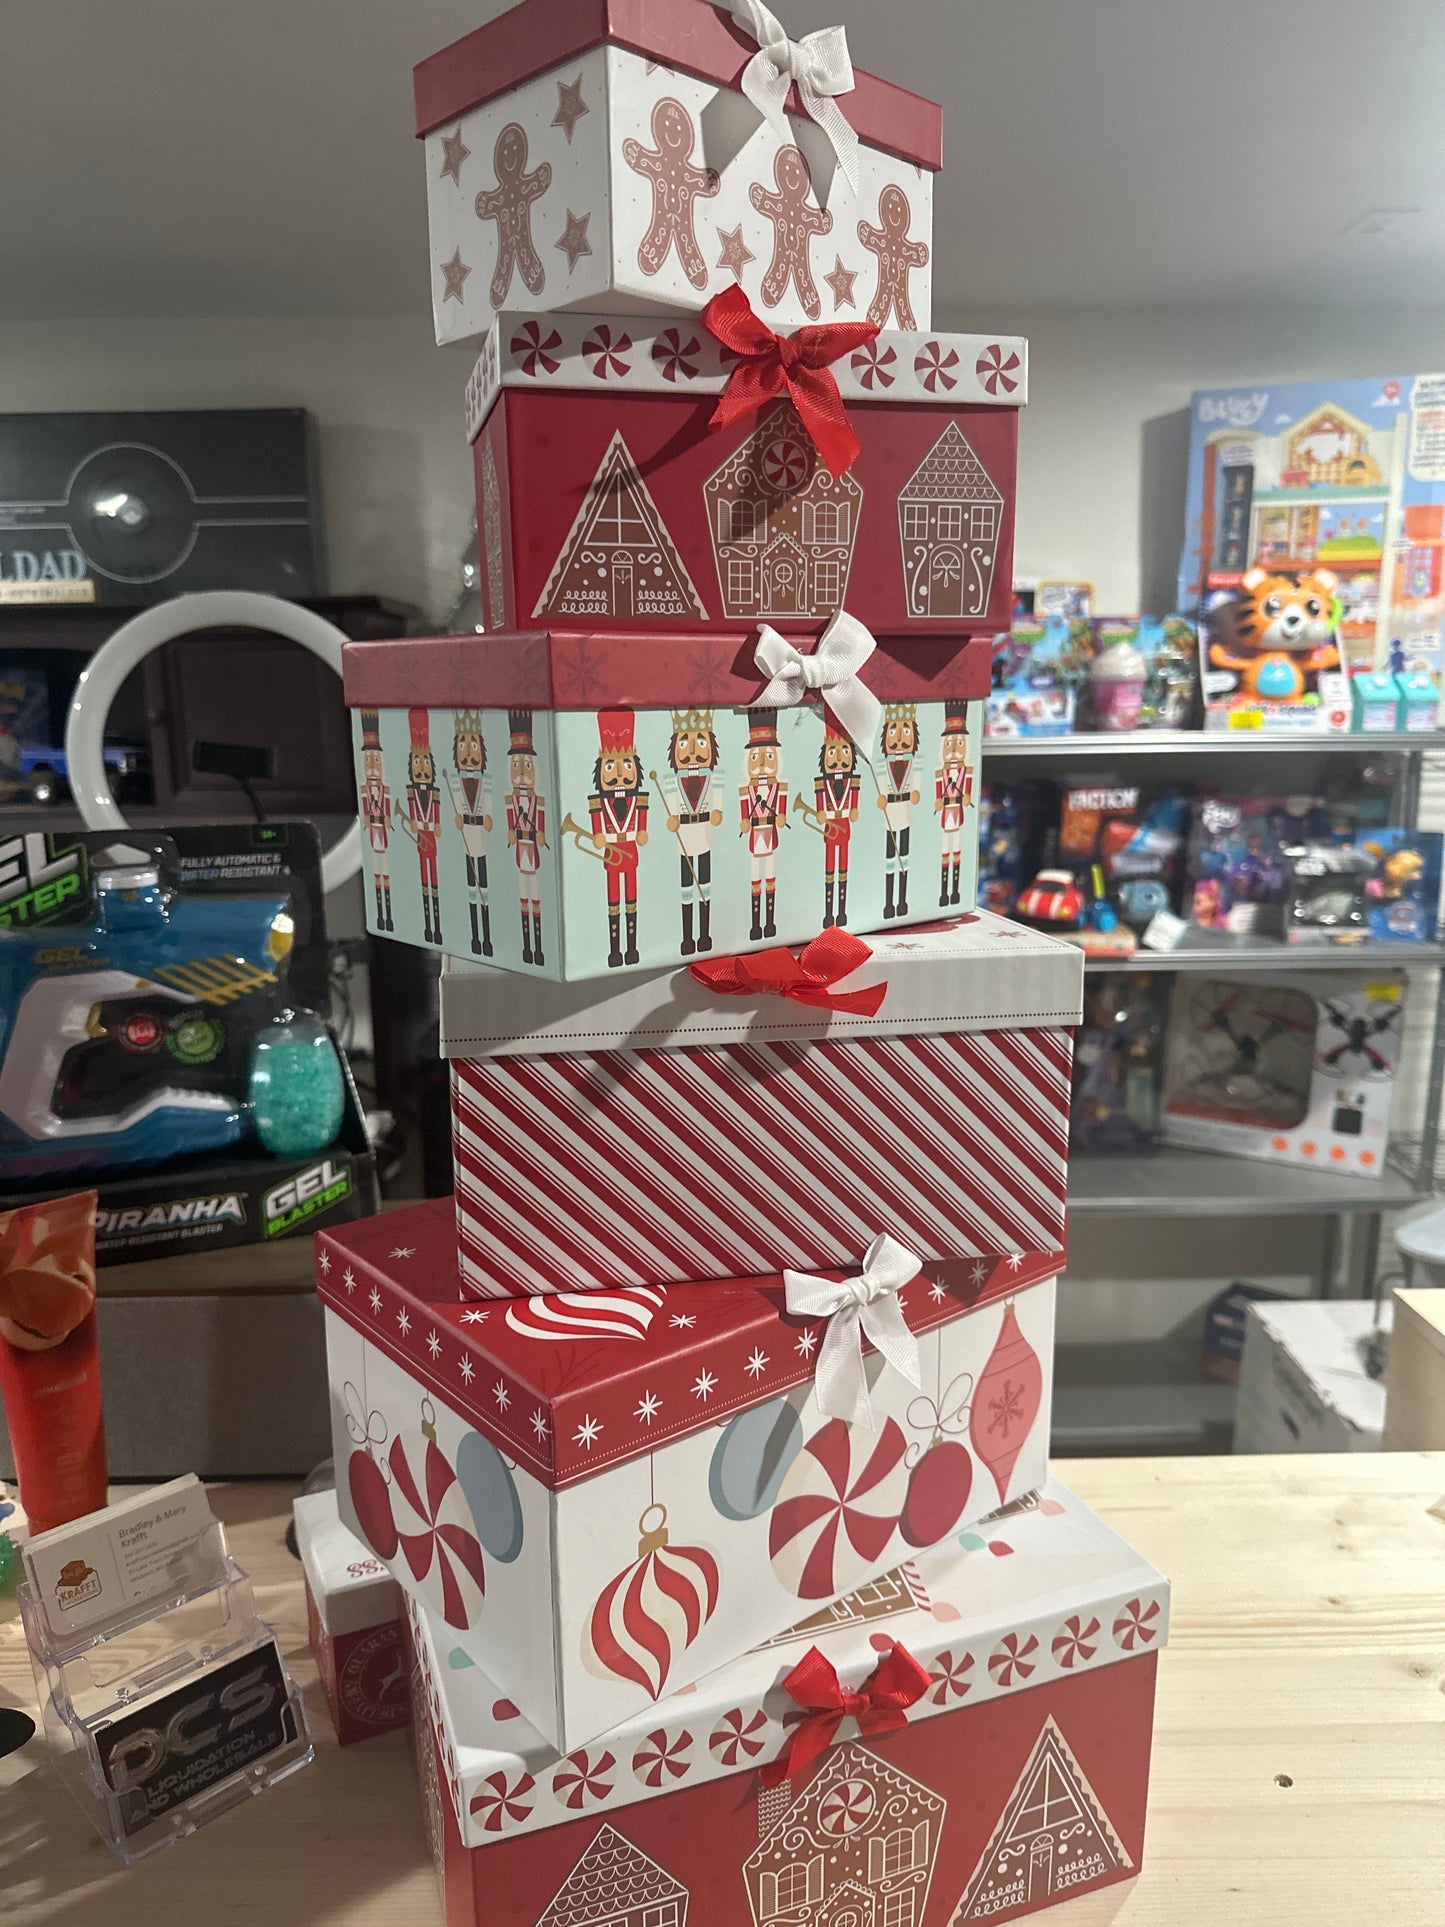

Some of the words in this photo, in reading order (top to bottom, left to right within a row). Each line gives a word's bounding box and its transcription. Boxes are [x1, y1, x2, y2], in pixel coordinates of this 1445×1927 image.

[180, 857, 213, 868] FULLY
[214, 853, 272, 866] AUTOMATIC
[220, 864, 281, 878] RESISTANT
[266, 1160, 347, 1219] GEL
[267, 1180, 348, 1235] BLASTER
[95, 1195, 244, 1232] PIRANHA
[119, 1520, 154, 1539] Bradley
[155, 1514, 163, 1523] &
[164, 1506, 187, 1520] Mary
[61, 1580, 97, 1602] KRAFFT
[147, 1730, 256, 1797] LIQUIDATION
[172, 1732, 279, 1797] WHOLESALE
